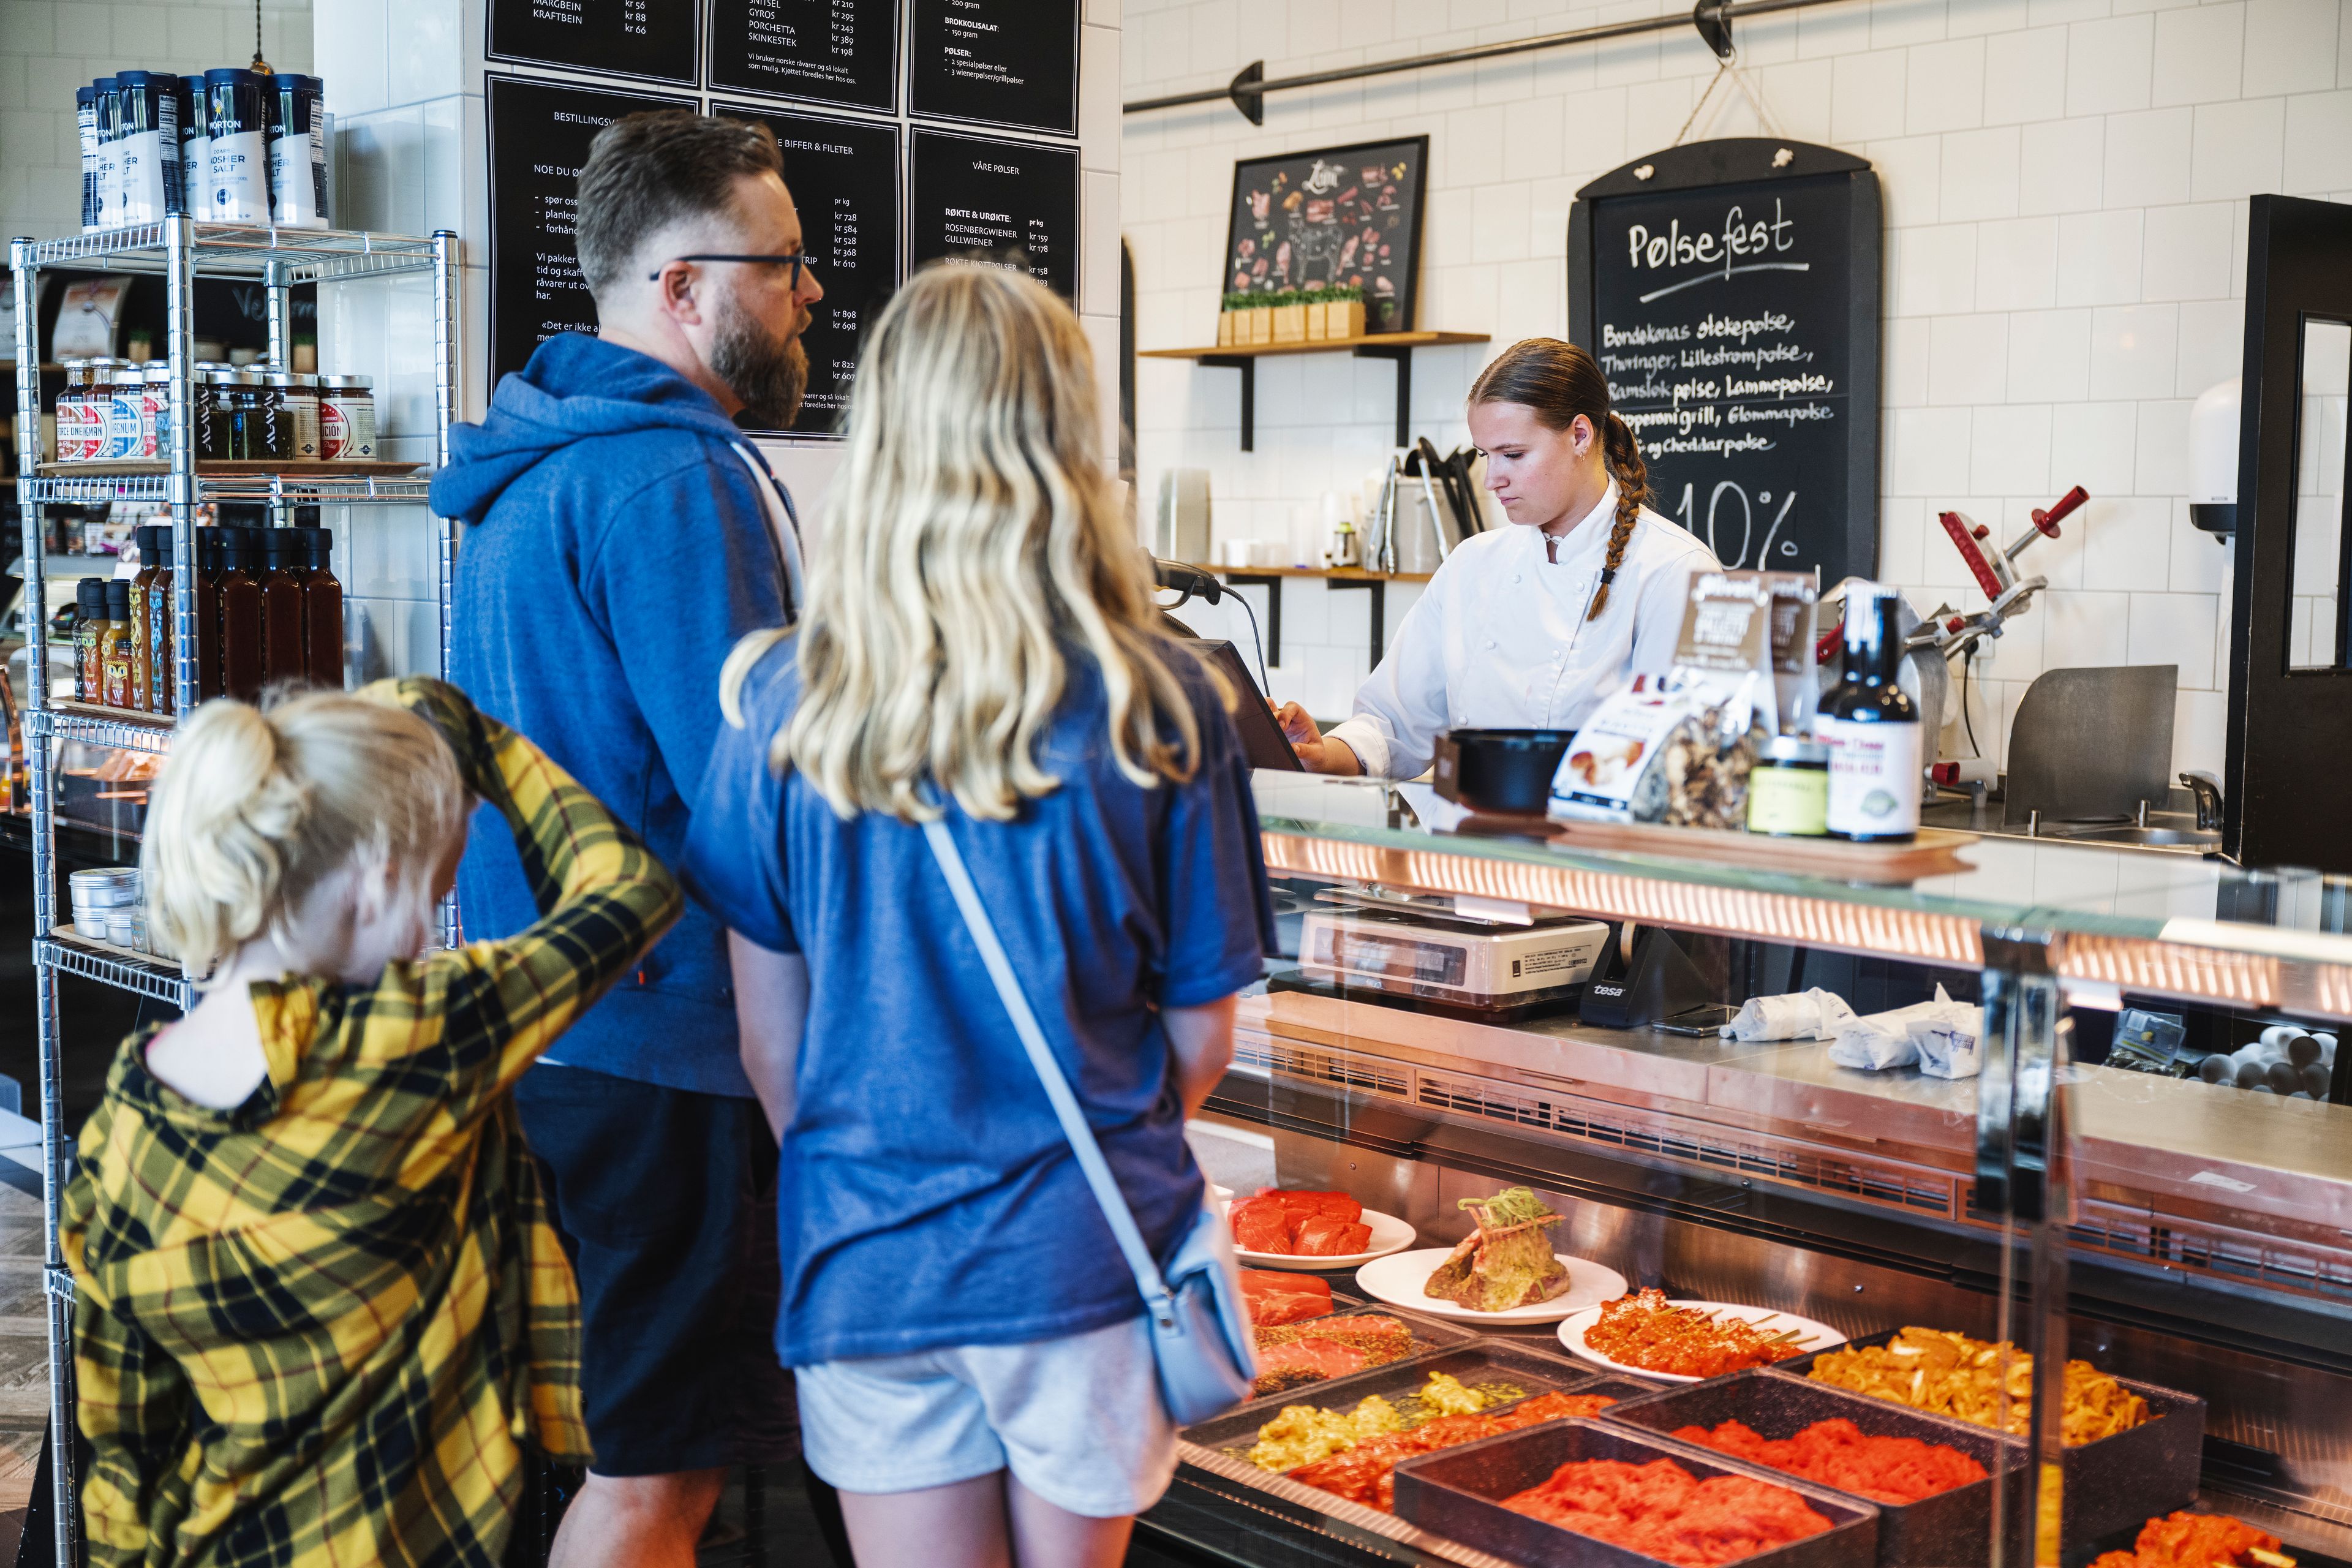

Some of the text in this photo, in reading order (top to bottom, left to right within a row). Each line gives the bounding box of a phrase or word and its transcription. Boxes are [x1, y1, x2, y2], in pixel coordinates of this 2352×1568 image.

[533, 9, 582, 24] KRAFTBEIN
[625, 10, 633, 20] kr
[749, 9, 775, 20] GYROS
[832, 9, 854, 21] kr 295
[625, 23, 646, 34] kr 66
[749, 20, 796, 35] PORCHETTA
[832, 22, 854, 34] kr 243
[945, 17, 1000, 32] BROKKOLISALAT:
[748, 32, 797, 47] SKINKESTEK
[831, 34, 854, 45] kr 389
[831, 45, 839, 53] kr
[944, 47, 971, 57] PØLSER:
[756, 54, 775, 62] bruker
[796, 60, 816, 69] råvarer
[832, 66, 848, 74] lokalt
[956, 60, 993, 70] spesialpølser
[761, 64, 780, 74] mulig.
[782, 67, 801, 75] Kjøttet
[802, 70, 824, 79] foredles
[956, 69, 1024, 84] wienerpølser/grillpølser
[554, 112, 615, 126] BESTILLINGSV
[209, 121, 242, 130] MORTON
[785, 140, 813, 150] BIFFER
[823, 144, 853, 154] FILETER
[534, 164, 570, 176] NOE DU
[973, 160, 1020, 175] VÅRE PØLSER
[545, 196, 563, 205] spør
[842, 198, 850, 206] kg
[945, 208, 970, 218] RØKTE
[979, 212, 1011, 222] URØKTE:
[844, 225, 858, 234] 584
[945, 224, 1017, 238] ROSENBERGWIENER
[945, 235, 993, 247] GULLWIENER
[1629, 197, 1793, 281] Pølsefest
[537, 252, 576, 264] Vi pakker
[945, 258, 968, 268] RØKTE
[537, 266, 548, 274] tid
[551, 268, 560, 277] og
[537, 278, 567, 288] råvarer
[536, 290, 551, 300] har.
[842, 311, 856, 319] 898
[575, 323, 592, 331] ikke
[842, 322, 856, 331] 698
[842, 360, 855, 369] 822
[842, 372, 855, 381] 607
[1594, 984, 1623, 997] tesa
